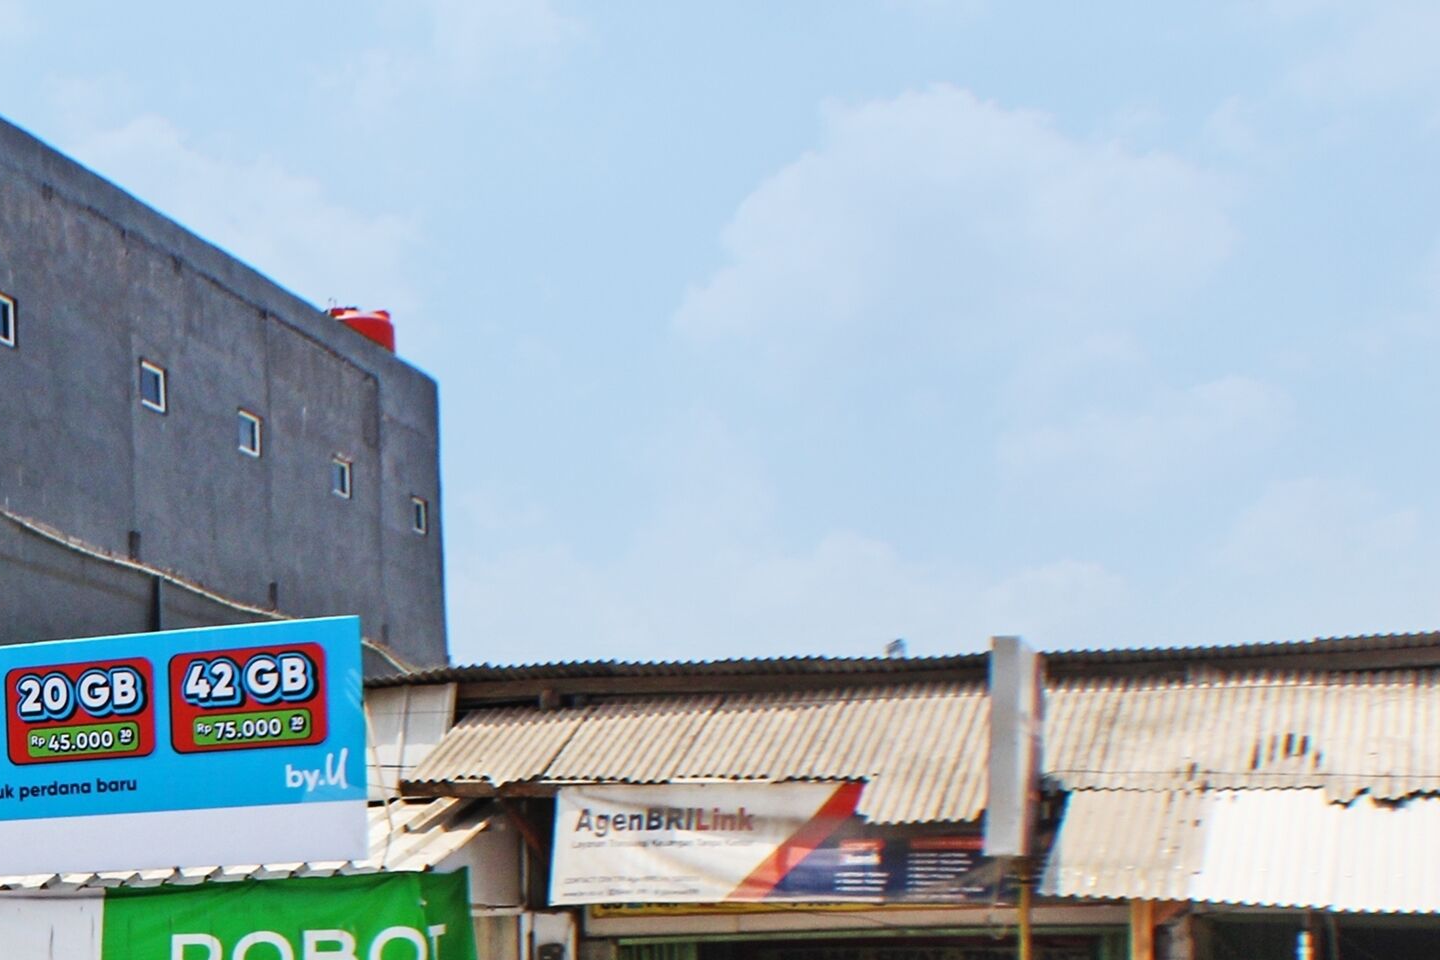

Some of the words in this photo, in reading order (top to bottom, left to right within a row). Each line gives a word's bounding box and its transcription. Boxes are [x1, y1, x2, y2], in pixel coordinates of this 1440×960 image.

[185, 662, 235, 699] 42
[246, 657, 308, 695] GB
[20, 677, 68, 713] 20
[80, 672, 137, 708] GB
[31, 735, 46, 747] Rp
[48, 730, 113, 750] 45.000
[196, 722, 213, 735] Rp
[215, 718, 282, 739] 75.000
[19, 780, 92, 801] perdana
[96, 778, 137, 793] baru
[575, 807, 755, 837] AgenBRILink
